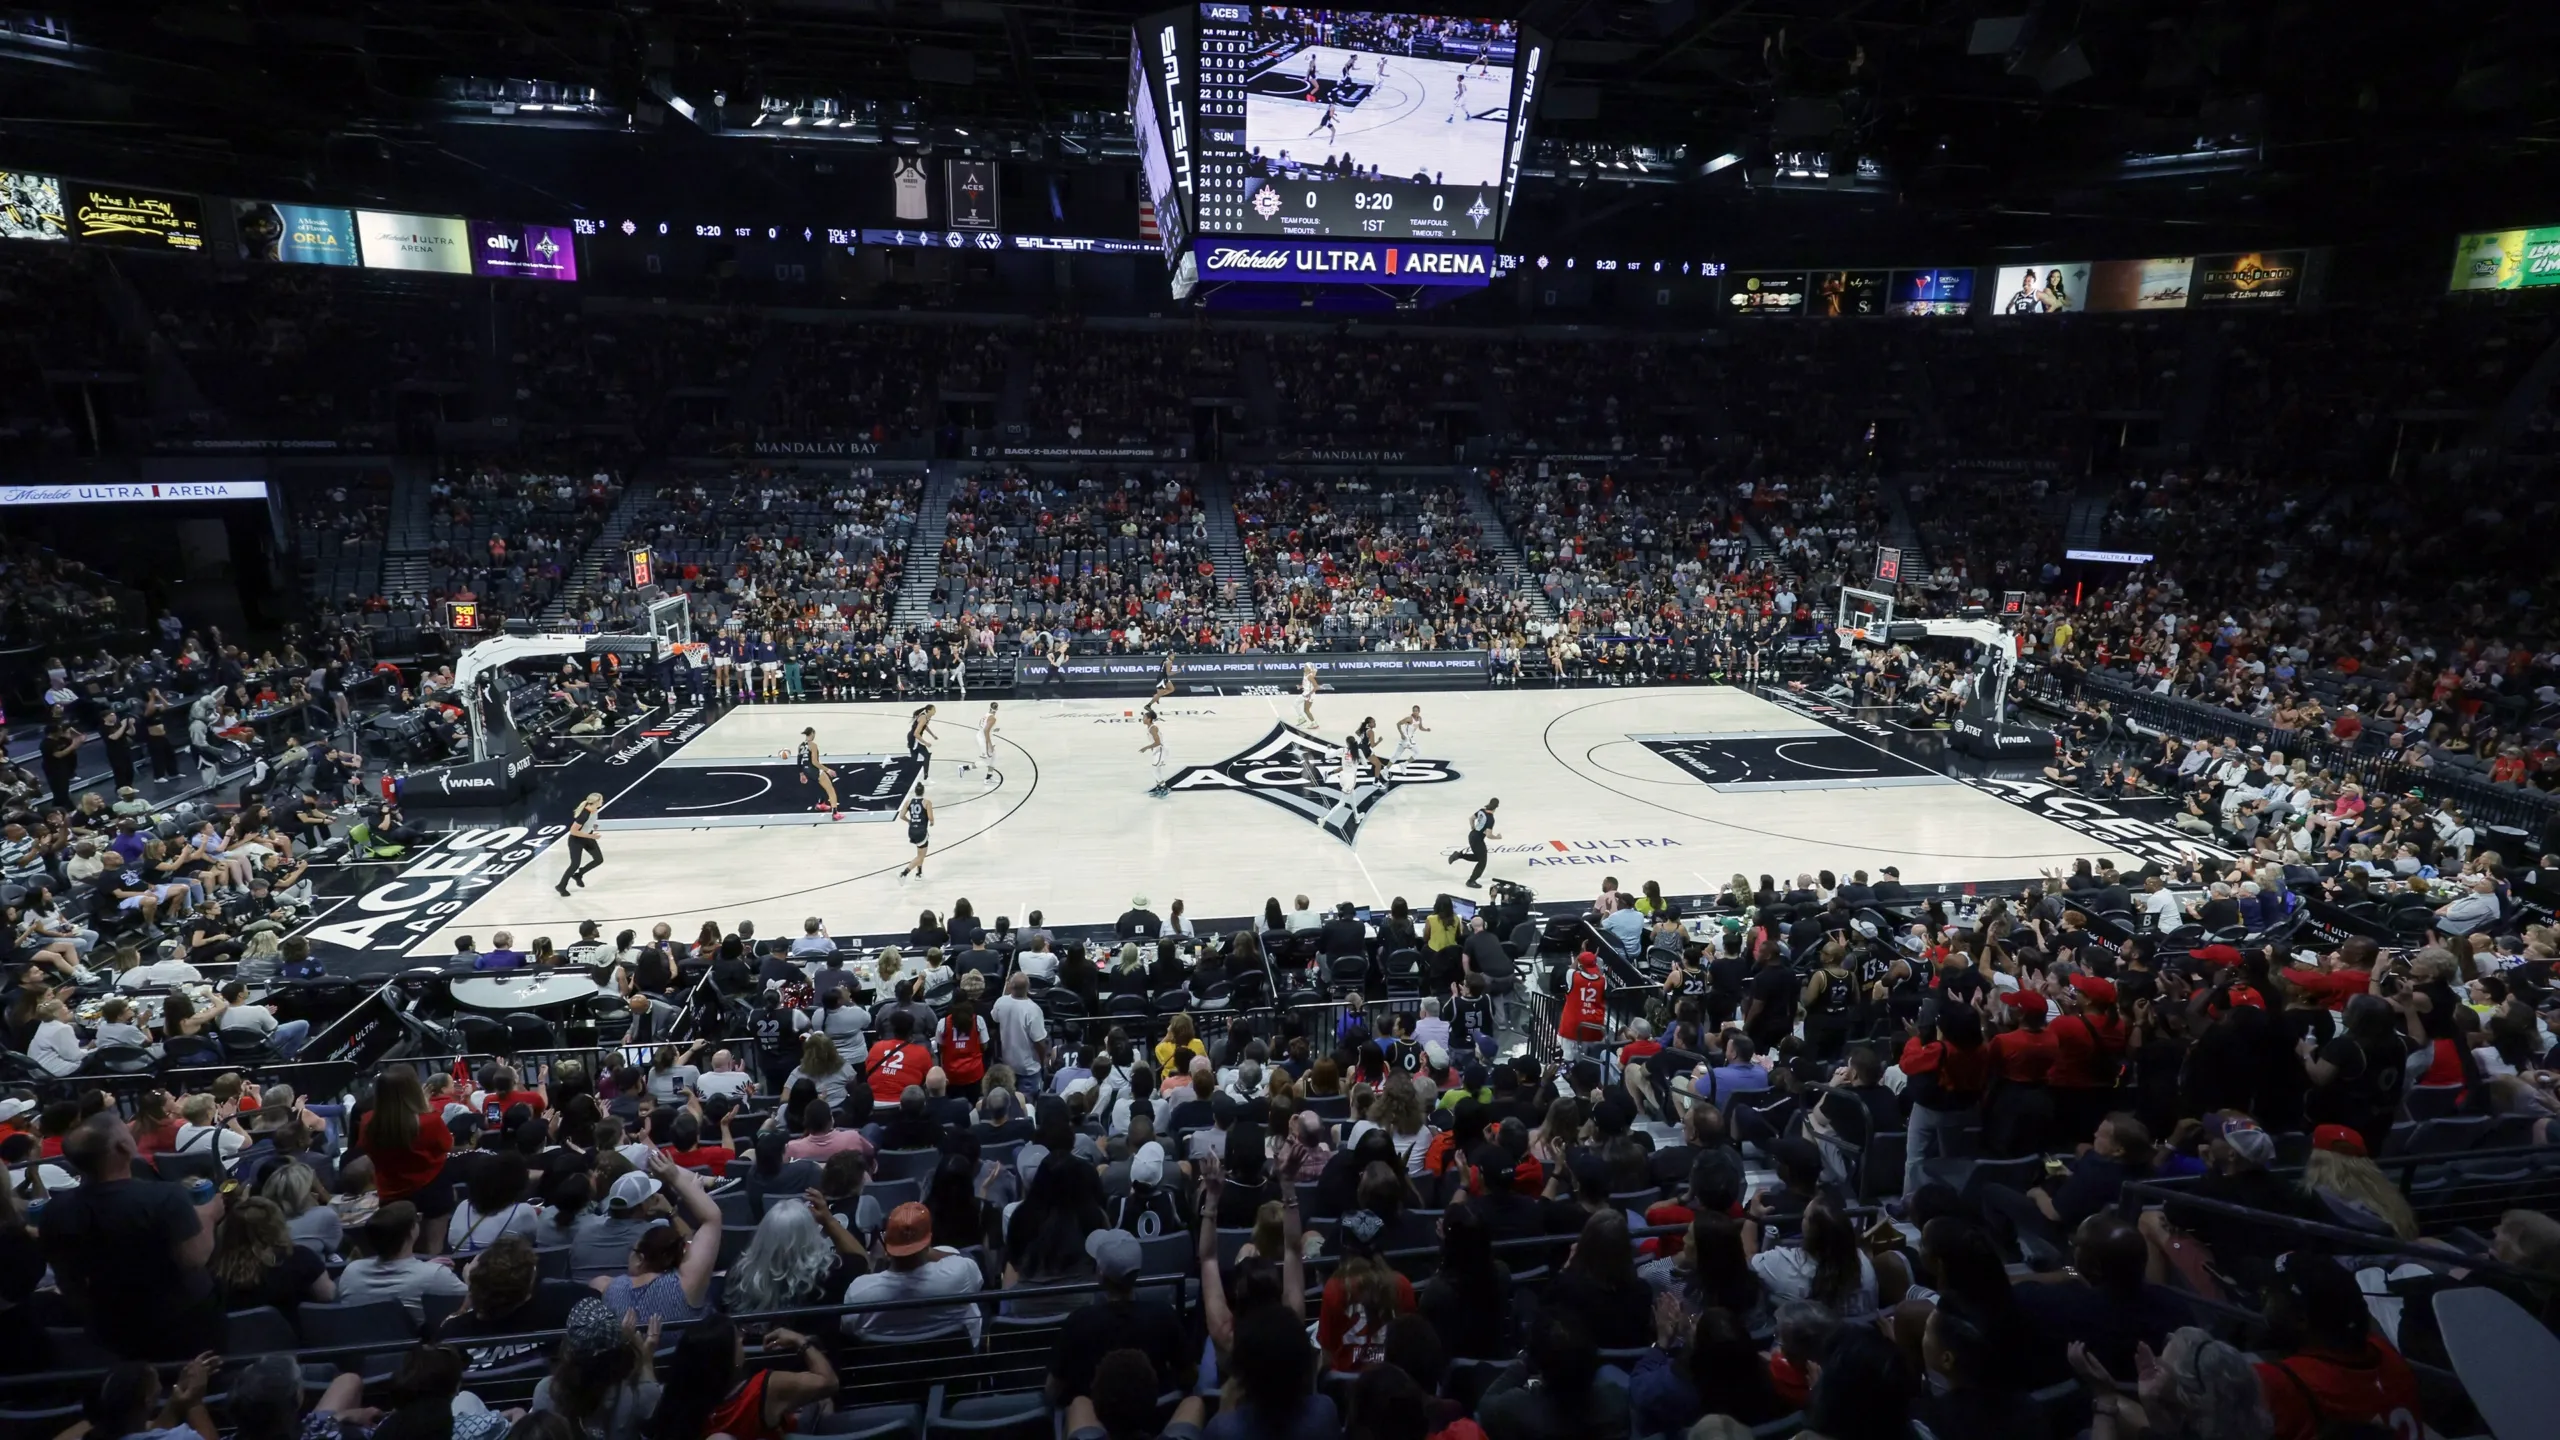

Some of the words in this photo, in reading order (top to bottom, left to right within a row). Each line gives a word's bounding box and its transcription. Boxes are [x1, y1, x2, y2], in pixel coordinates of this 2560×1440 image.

[1211, 7, 1239, 19] ACES
[1203, 41, 1209, 51] 0
[1216, 42, 1223, 52] 0
[1200, 57, 1211, 67] 10
[1216, 58, 1222, 68] 0
[1200, 73, 1211, 83] 15
[1216, 73, 1222, 83] 0
[1200, 89, 1211, 99] 22
[1216, 89, 1222, 99] 0
[1160, 25, 1193, 195] SALIENT
[1200, 103, 1211, 113] 41
[1216, 104, 1222, 114] 0
[1505, 46, 1541, 206] SALIENT
[1213, 131, 1234, 142] SUN
[1200, 164, 1211, 174] 21
[1200, 178, 1211, 187] 24
[1200, 193, 1211, 203] 25
[1306, 191, 1317, 209] 0
[1354, 192, 1393, 210] 9:20
[1432, 194, 1444, 212] 0
[1200, 207, 1211, 216] 42
[1467, 208, 1491, 216] ACES
[574, 219, 595, 227] TOL:
[599, 220, 605, 228] 5
[1200, 221, 1211, 230] 52
[1280, 216, 1298, 224] TEAM
[1299, 217, 1321, 225] FOULS:
[1362, 219, 1385, 232] 1ST
[1427, 219, 1449, 227] FOULS:
[576, 226, 596, 234] FLS:
[660, 223, 667, 234] 0
[696, 225, 721, 236] 9:20
[735, 228, 750, 236] 1ST
[768, 228, 776, 238] 0
[1283, 227, 1316, 235] TIMEOUTS:
[1412, 229, 1444, 237] TIMEOUTS:
[293, 232, 337, 245] ORLA
[420, 236, 454, 245] ULTRA
[487, 234, 519, 253] ally
[830, 235, 848, 243] FLS:
[1015, 237, 1095, 250] SALIENT
[401, 245, 433, 253] ARENA
[1206, 247, 1290, 270] Michelob
[1296, 250, 1377, 272] ULTRA
[1404, 252, 1486, 274] ARENA
[1500, 254, 1516, 262] TOL:
[1519, 255, 1525, 263] 5
[1500, 261, 1516, 269] FLS:
[1567, 258, 1574, 268] 0
[1596, 260, 1616, 270] 9:20
[1654, 262, 1660, 271] 0
[1720, 263, 1725, 271] 5
[2227, 290, 2238, 299] of
[2259, 289, 2286, 298] Music
[755, 442, 845, 453] MANDALAY
[851, 443, 879, 454] BAY
[1004, 447, 1069, 456] BACK-2-BACK
[1070, 448, 1098, 456] WNBA
[1099, 448, 1154, 457] CHAMPIONS
[1312, 450, 1379, 460] MANDALAY
[1383, 451, 1405, 461] BAY
[4, 486, 72, 501] Michelob
[79, 487, 144, 499] ULTRA
[168, 485, 228, 497] ARENA
[1880, 561, 1897, 579] 23
[2006, 602, 2018, 612] 23
[455, 615, 471, 626] 23
[1031, 666, 1065, 674] WNA
[1068, 665, 1100, 673] PRIDE
[1110, 665, 1144, 673] WNBA
[1188, 664, 1222, 672] WNBA
[1224, 663, 1255, 671] PRIDE
[1339, 661, 1371, 669] WNBA
[1412, 660, 1444, 668] WNBA
[1824, 710, 1894, 736] ULTRA
[1964, 725, 1982, 738] AT&T
[2001, 736, 2031, 745] WNBA
[516, 754, 531, 773] AT&T
[2312, 755, 2320, 764] C
[449, 778, 495, 788] WNBA
[871, 770, 902, 796] WNBA
[910, 803, 921, 814] 10
[1961, 778, 2031, 804] LAS
[2042, 810, 2182, 866] VEGAS
[1984, 777, 2240, 862] ACES
[1573, 838, 1682, 850] ULTRA
[1528, 854, 1629, 867] ARENA
[305, 826, 529, 950] ACES
[372, 900, 463, 951] LAS
[457, 824, 568, 891] VEGAS
[2143, 914, 2152, 927] B
[2313, 929, 2339, 944] ARENA
[1683, 980, 1704, 995] 22
[1580, 987, 1597, 1003] 12
[1465, 1010, 1483, 1028] 51
[354, 1019, 380, 1041] ULTRA
[756, 1020, 780, 1037] 22
[343, 1042, 366, 1062] ARENA
[1063, 1052, 1079, 1068] 12
[1404, 1053, 1416, 1071] 0
[882, 1067, 897, 1076] GRAY
[1137, 1210, 1161, 1240] 0
